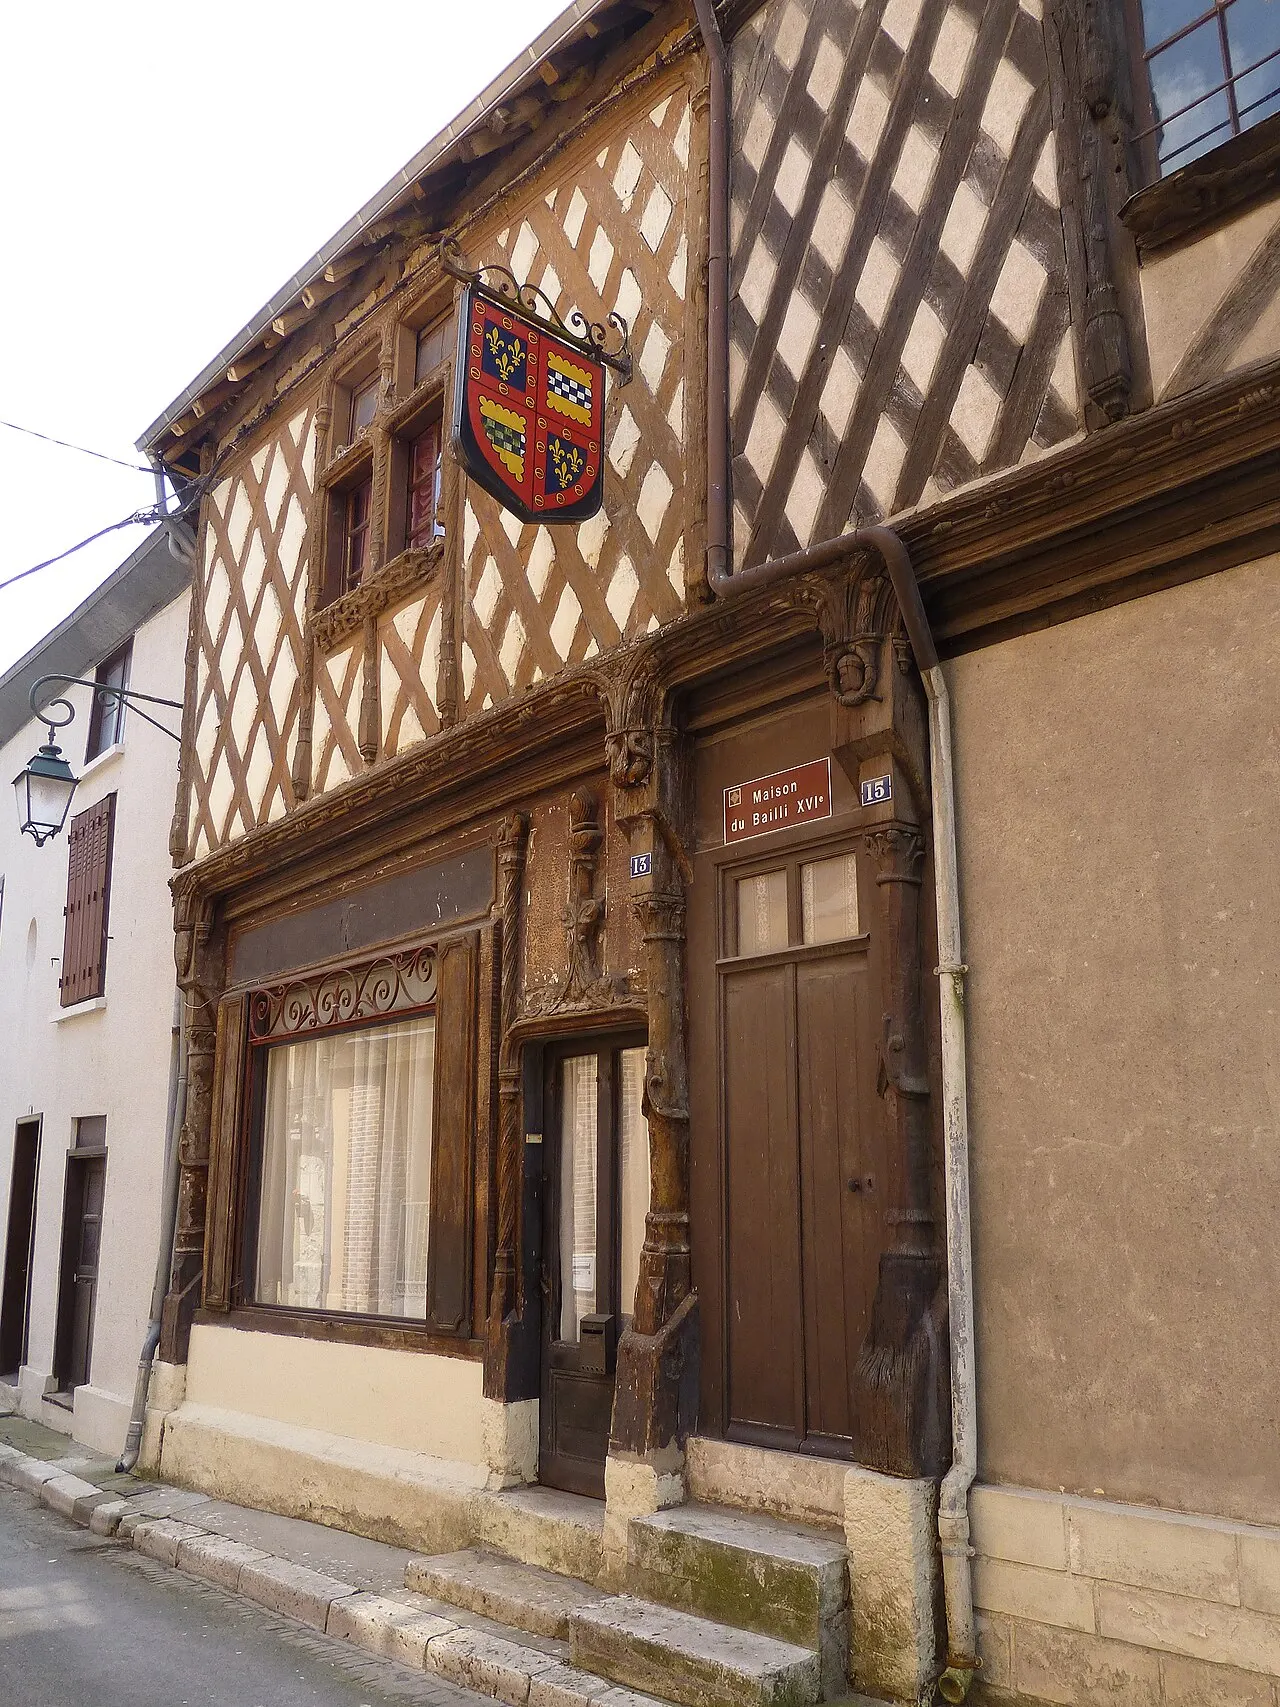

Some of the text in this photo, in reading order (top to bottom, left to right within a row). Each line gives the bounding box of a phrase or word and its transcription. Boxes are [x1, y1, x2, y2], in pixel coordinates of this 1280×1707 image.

[753, 781, 797, 804] Maison
[866, 780, 885, 802] 15
[731, 795, 824, 832] du Bailli XVIe
[634, 856, 647, 874] 13
